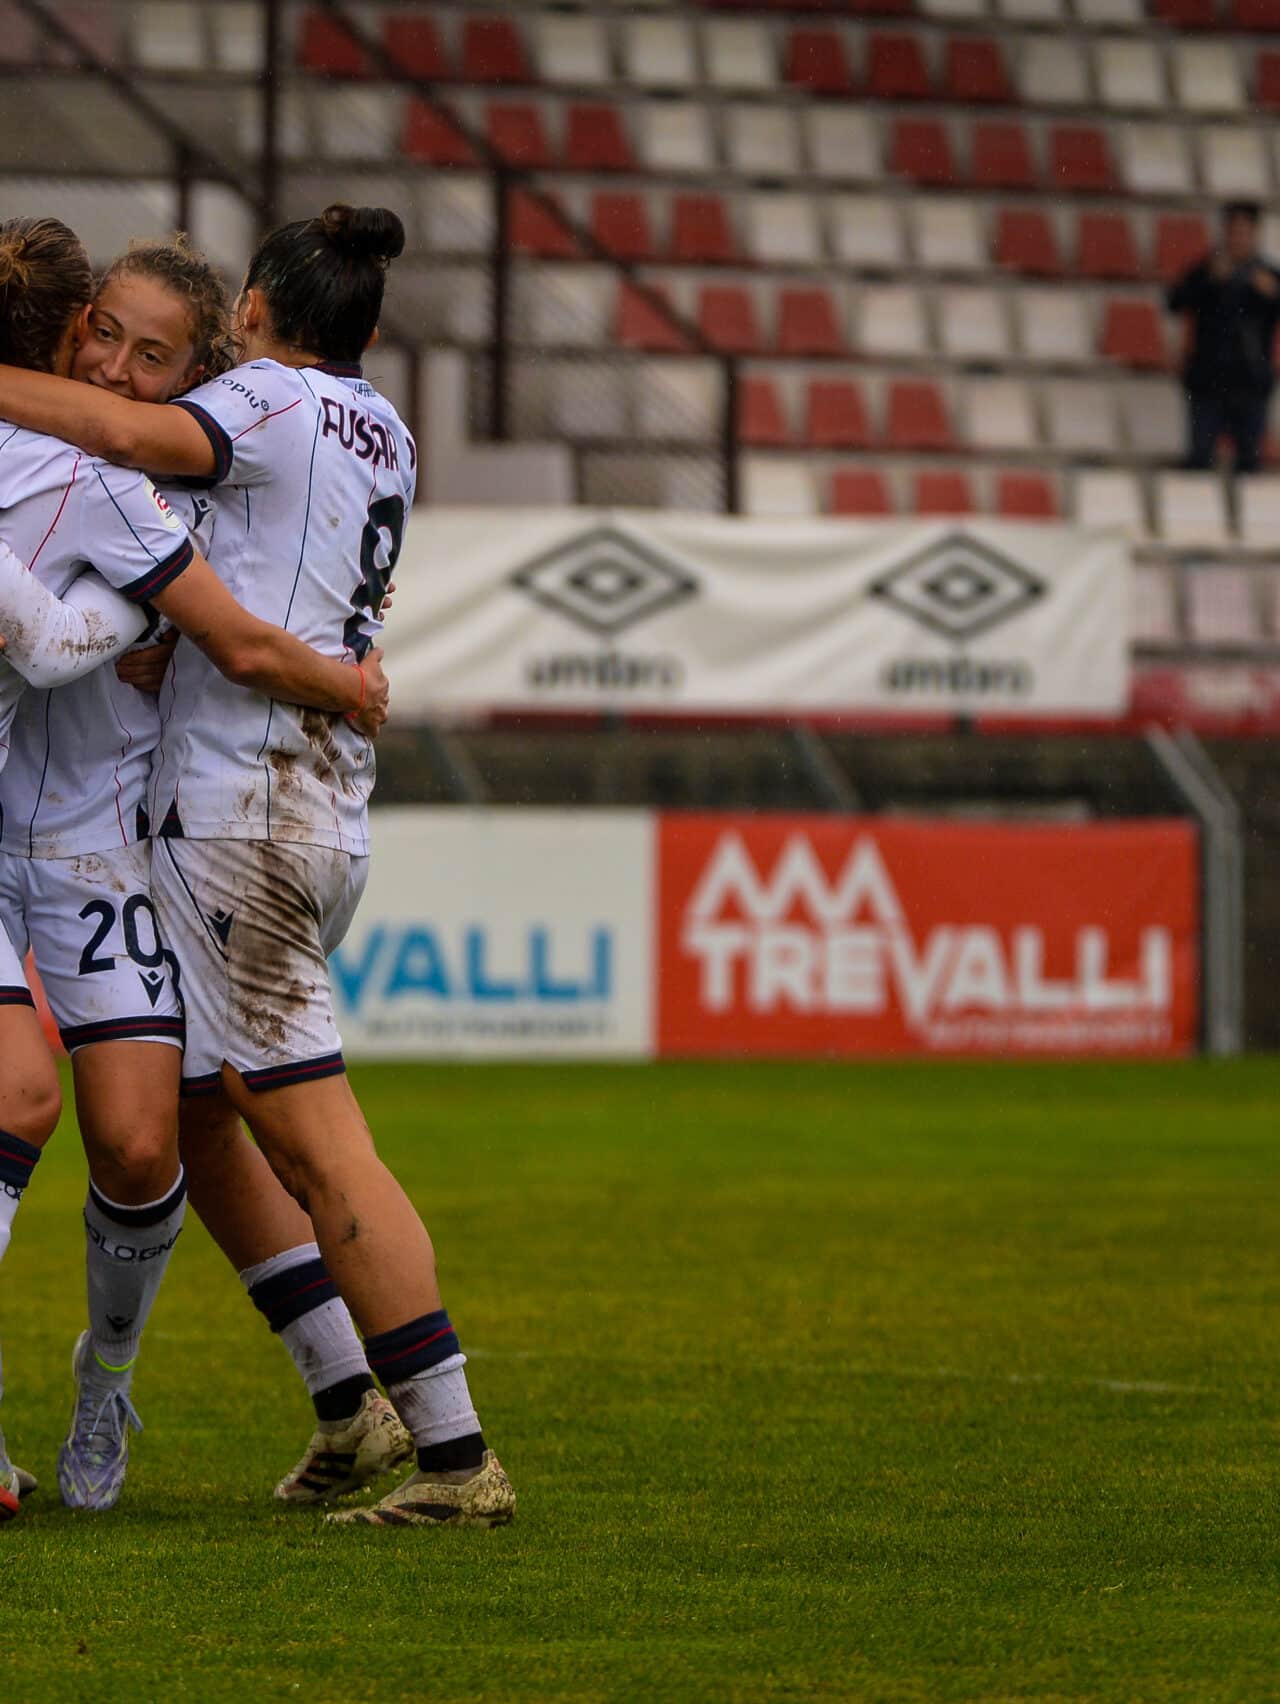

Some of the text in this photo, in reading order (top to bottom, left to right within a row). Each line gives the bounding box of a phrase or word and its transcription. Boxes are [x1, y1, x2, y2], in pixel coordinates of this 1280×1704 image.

[525, 650, 682, 692] umbro
[880, 654, 1035, 694] umbro
[78, 893, 165, 976] 20
[682, 920, 1172, 1036] TREVALLI
